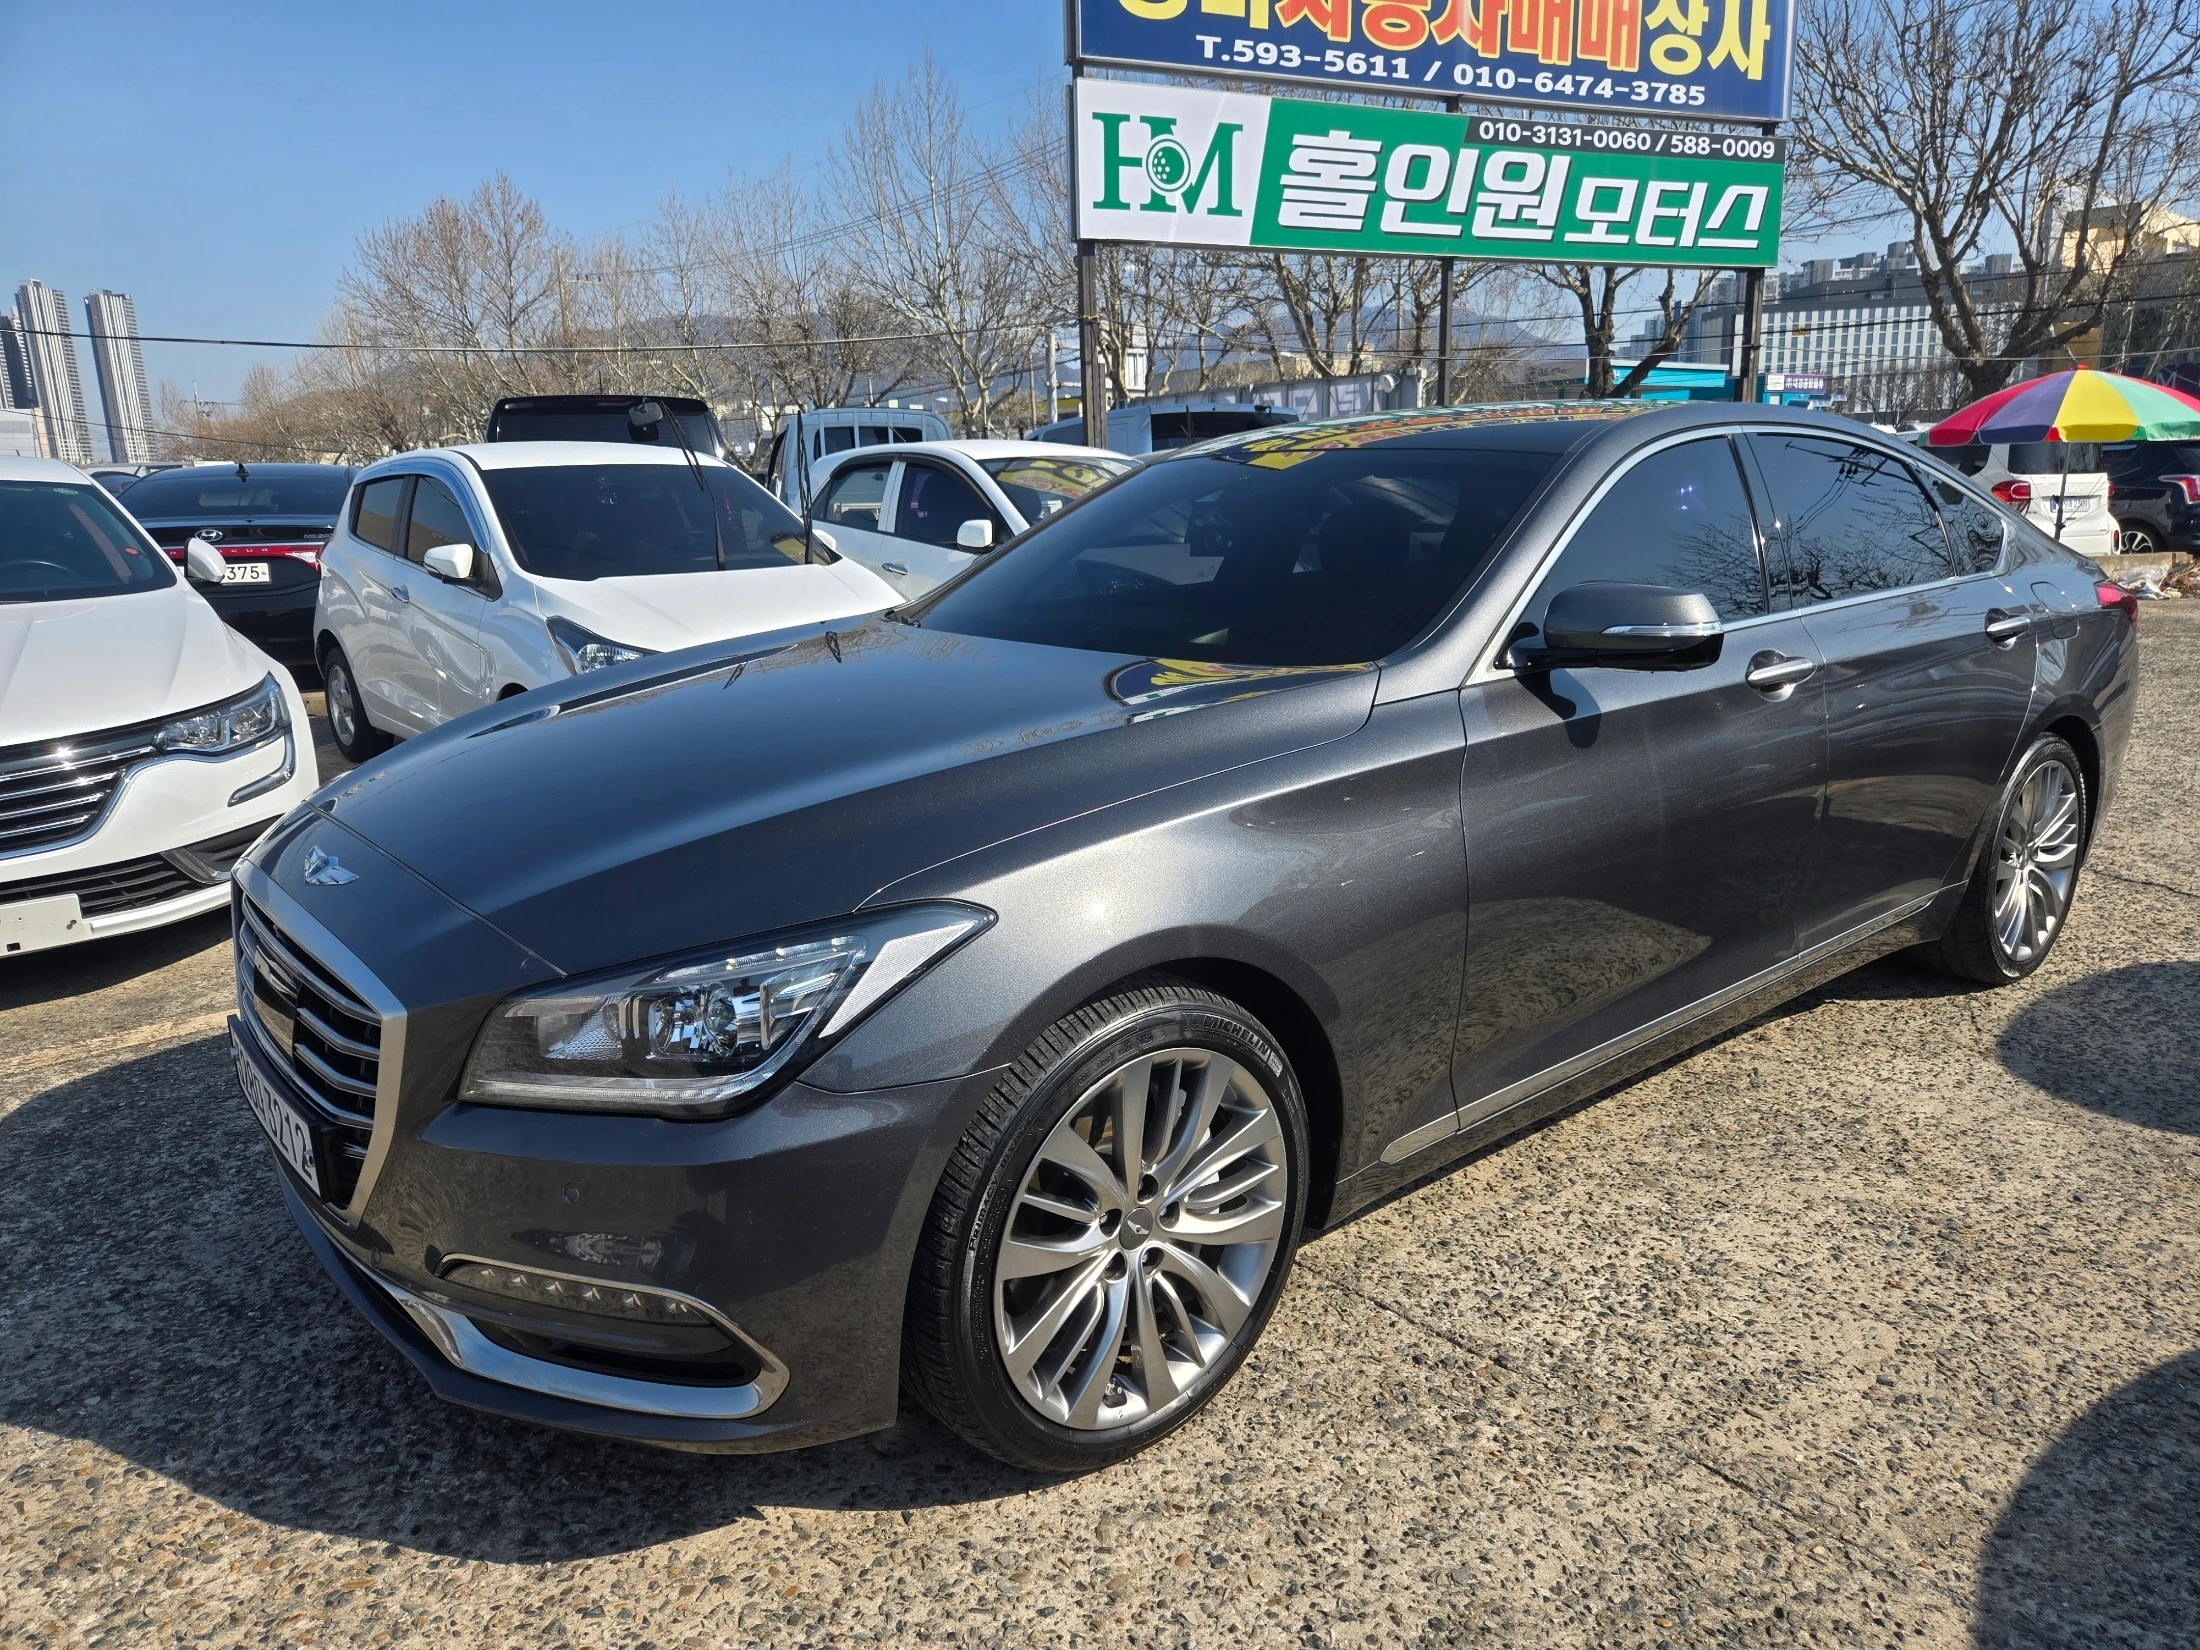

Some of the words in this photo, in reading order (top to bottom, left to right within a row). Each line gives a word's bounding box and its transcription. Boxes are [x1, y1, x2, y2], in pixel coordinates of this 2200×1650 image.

[1196, 35, 1410, 79] T.593-5611
[1453, 63, 1706, 106] 010-6474-3785
[1479, 121, 1651, 150] 010-3131-0060
[1670, 134, 1775, 159] 588-0009
[222, 566, 260, 580] 375
